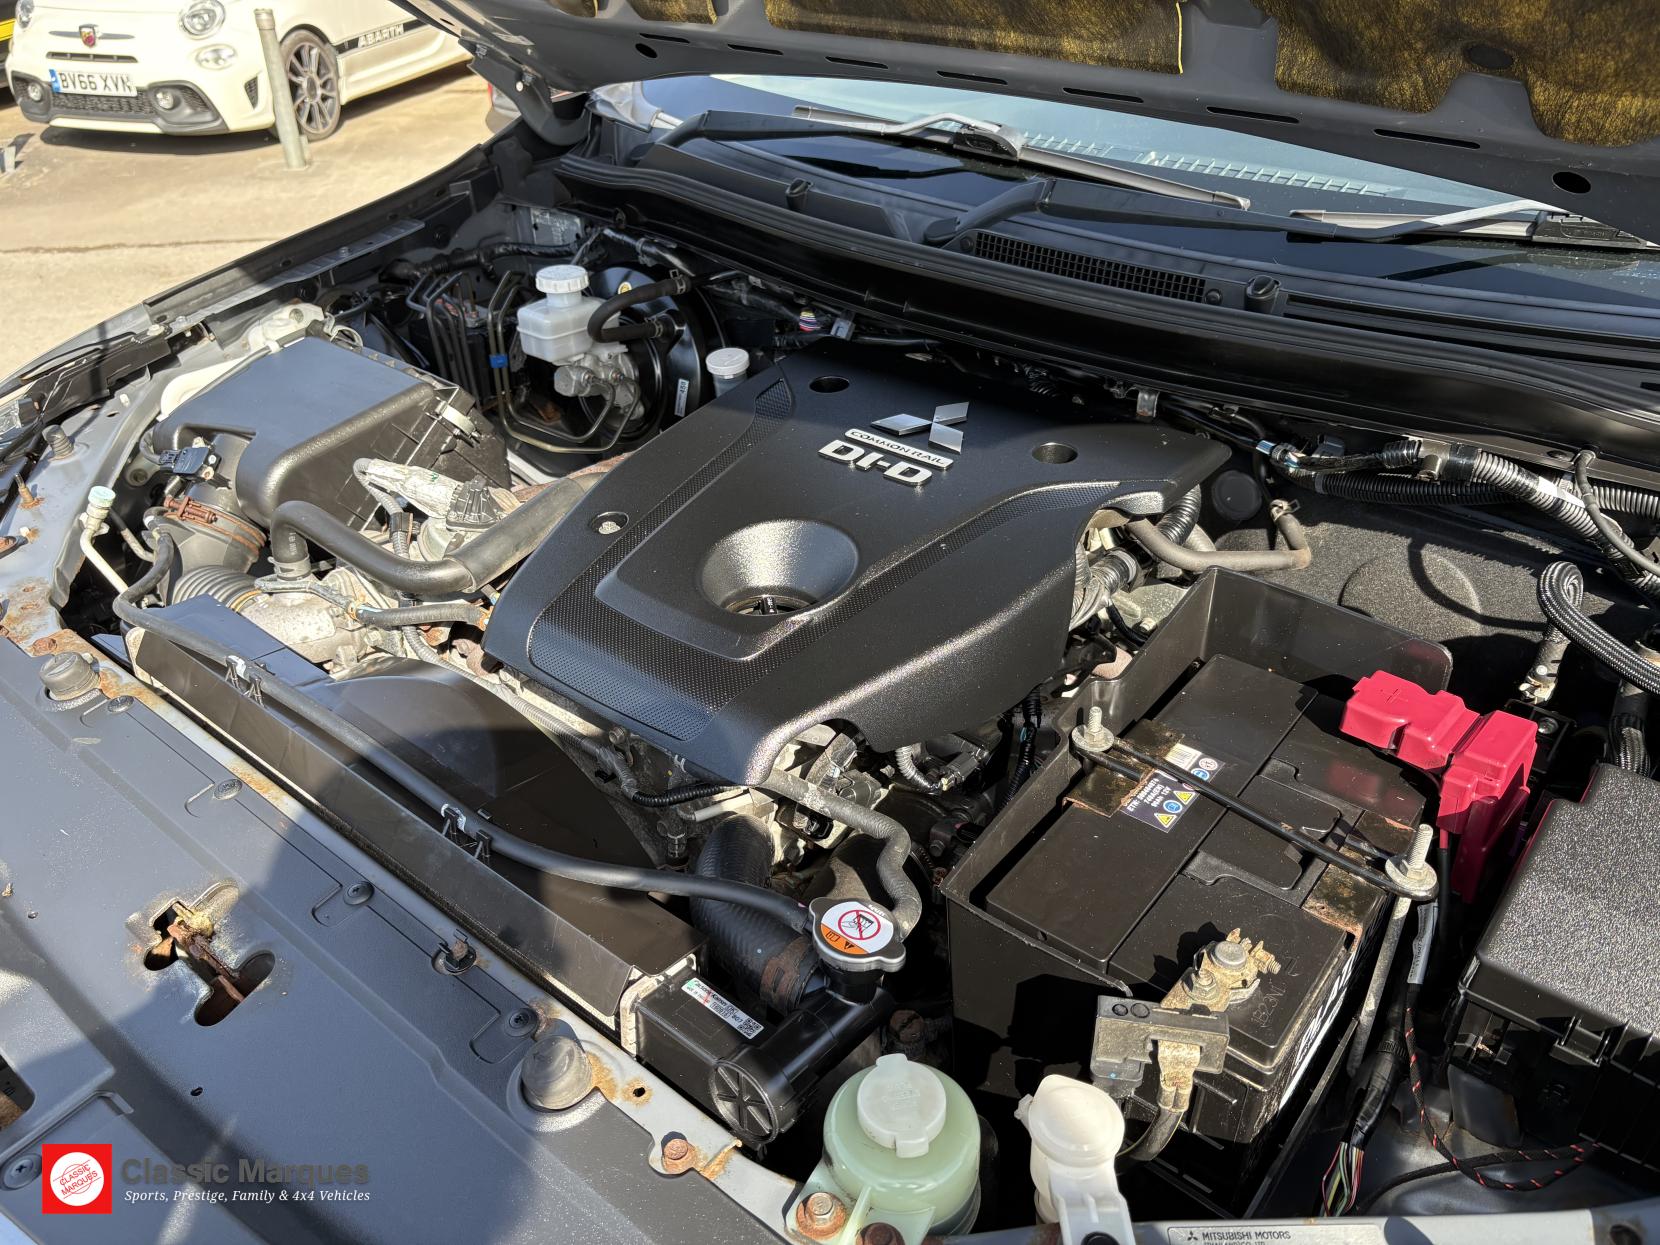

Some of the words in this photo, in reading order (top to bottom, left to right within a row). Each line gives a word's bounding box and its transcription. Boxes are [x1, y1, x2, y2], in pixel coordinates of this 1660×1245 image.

[358, 23, 404, 48] ABARTH
[59, 72, 97, 91] BV66
[850, 430, 909, 453] COMMON
[910, 445, 945, 465] RAIL
[818, 439, 932, 484] DI-D
[1202, 1231, 1252, 1241] MITSUBISHI
[1254, 1230, 1291, 1240] MOTORS
